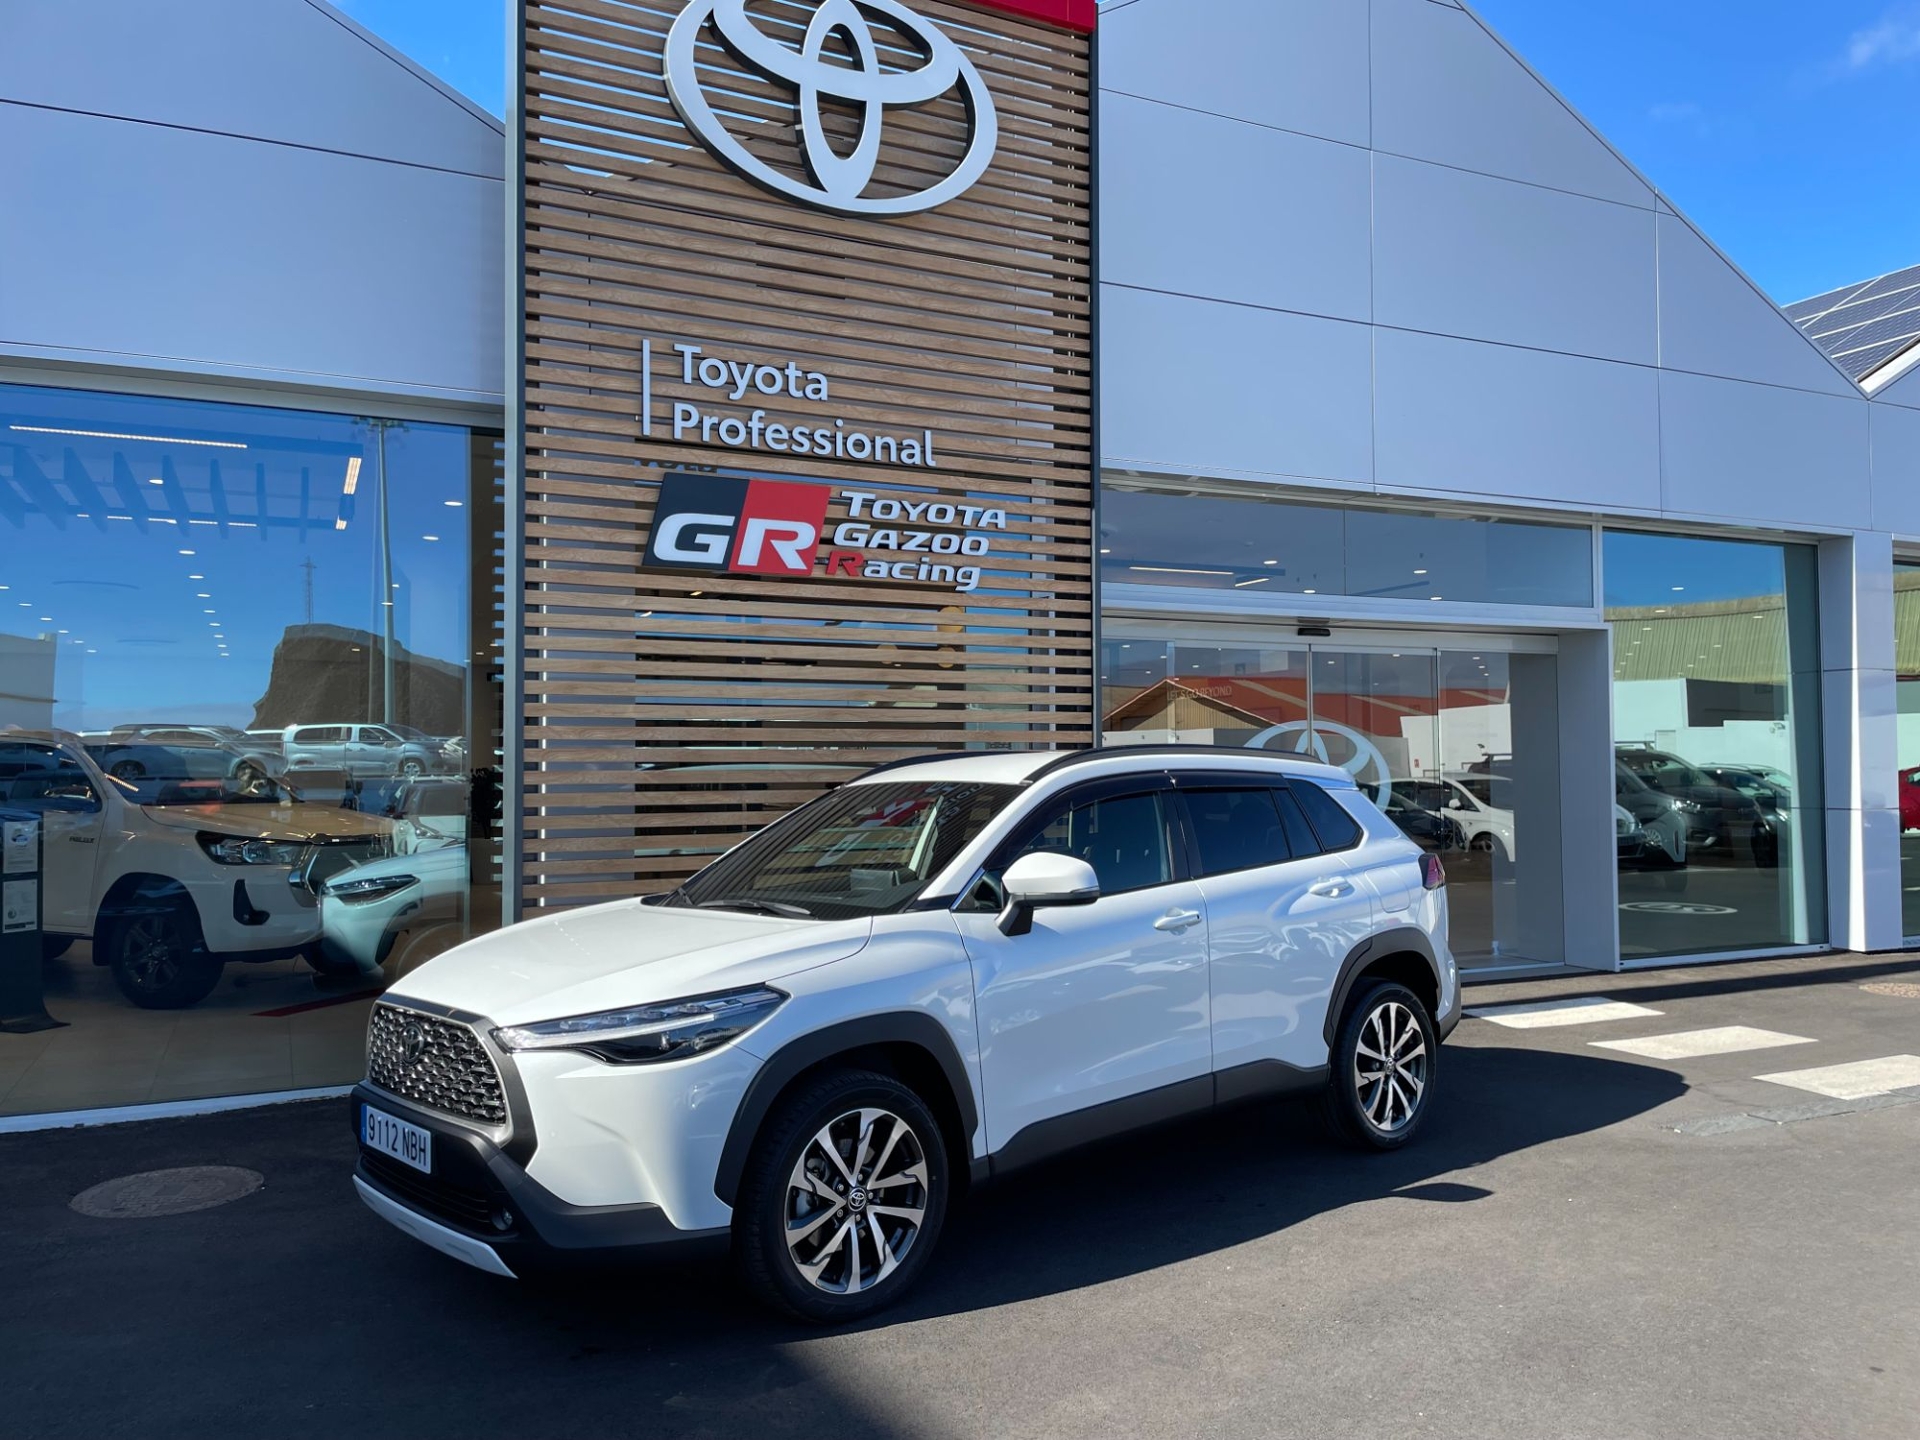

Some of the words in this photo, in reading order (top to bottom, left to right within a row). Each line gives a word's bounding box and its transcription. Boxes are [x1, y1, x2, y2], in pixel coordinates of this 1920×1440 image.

[673, 343, 829, 401] Toyota
[673, 402, 937, 467] Professional
[840, 490, 1006, 529] TOYOTA
[653, 512, 816, 570] GR
[833, 522, 990, 556] GAZOO
[826, 550, 981, 591] Racing
[368, 1113, 398, 1153] 9112
[402, 1127, 426, 1167] NBH
